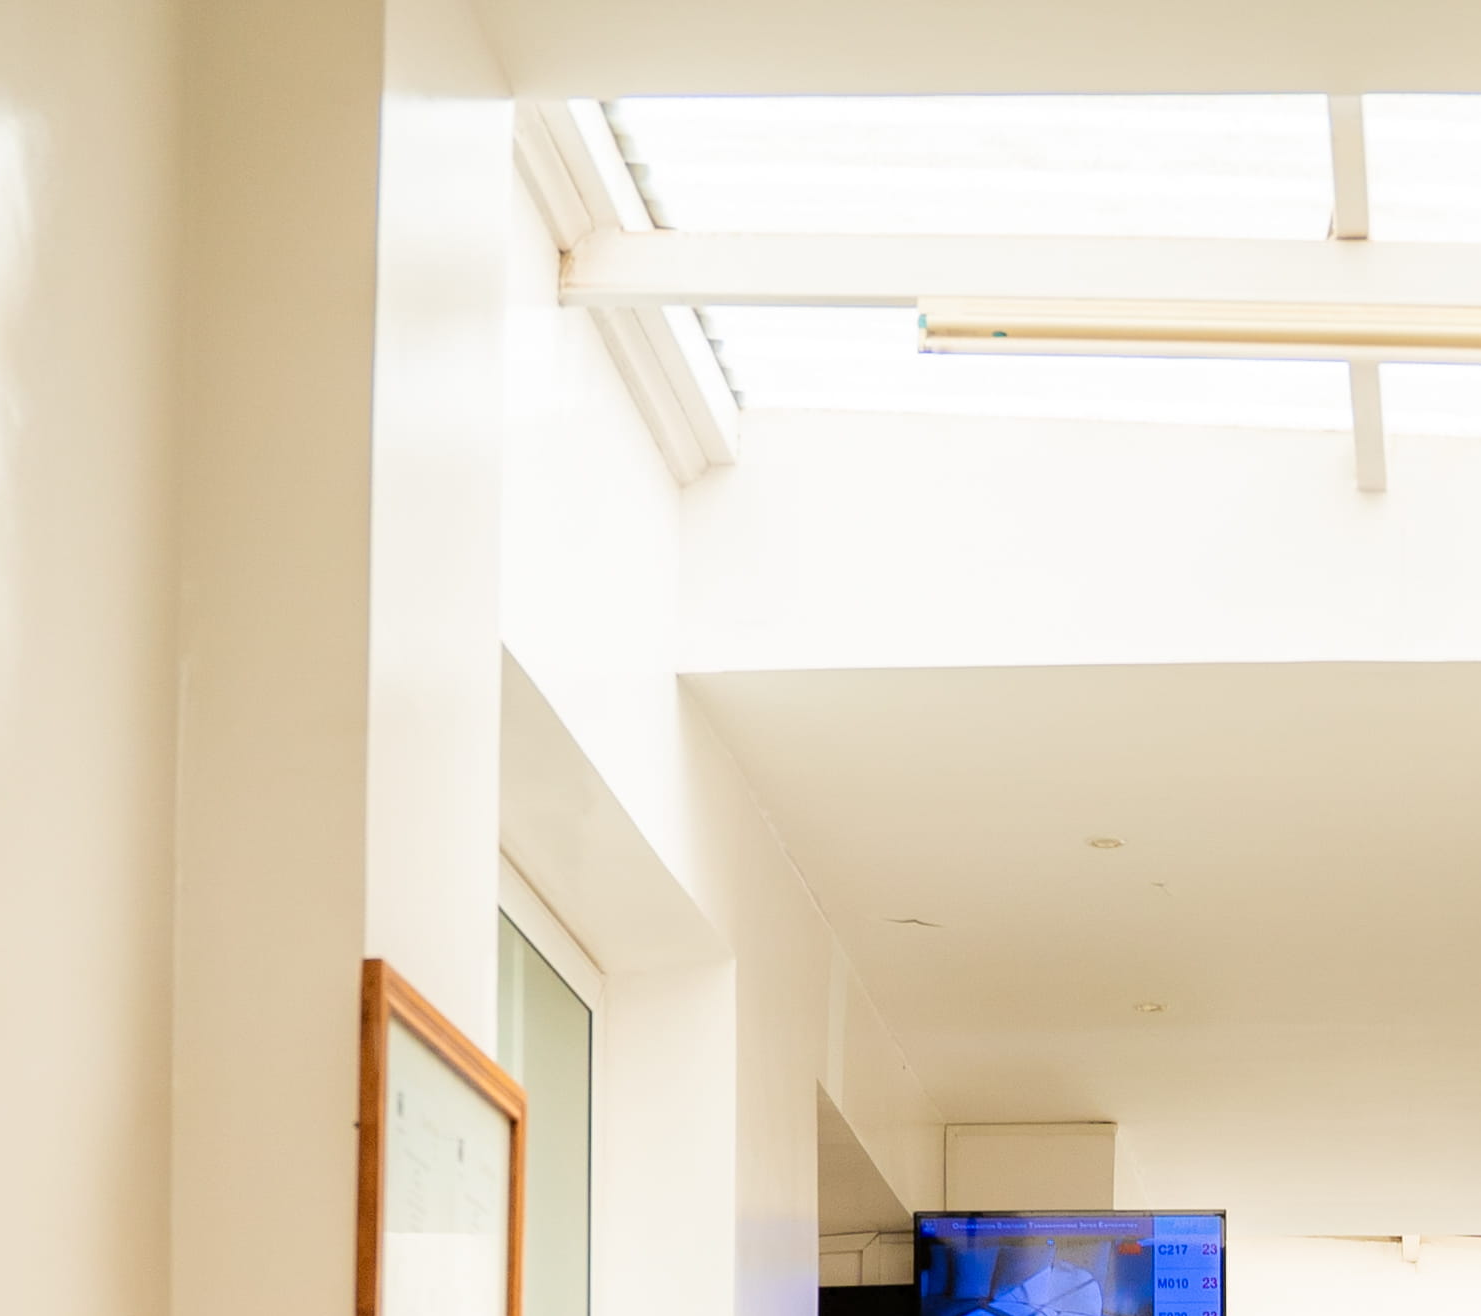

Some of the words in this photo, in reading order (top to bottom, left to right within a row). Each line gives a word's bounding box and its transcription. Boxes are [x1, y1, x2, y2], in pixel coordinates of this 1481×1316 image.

[1157, 1243, 1188, 1255] C217
[1201, 1243, 1218, 1255] 23
[1157, 1278, 1189, 1289] M010
[1201, 1277, 1218, 1289] 23
